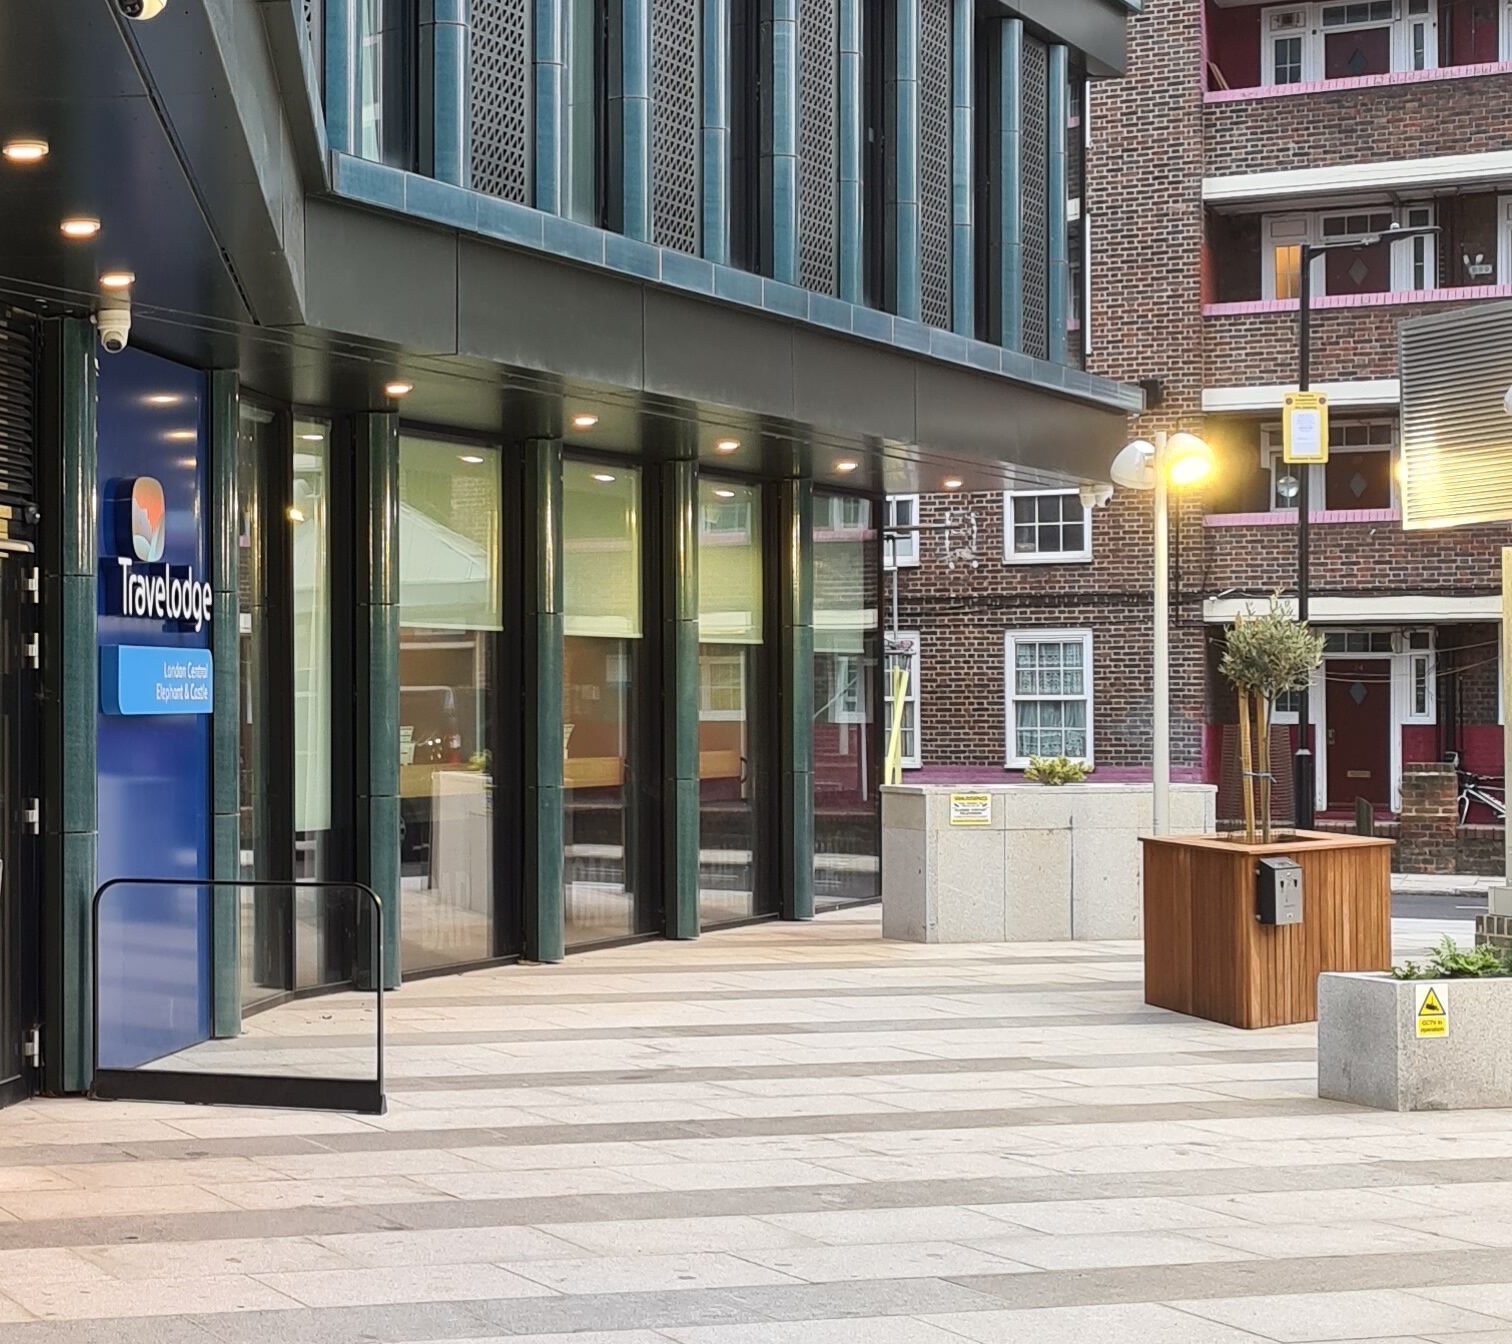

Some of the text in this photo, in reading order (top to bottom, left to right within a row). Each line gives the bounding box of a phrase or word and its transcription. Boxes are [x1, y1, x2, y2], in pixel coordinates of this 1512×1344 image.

[118, 557, 212, 632] Travelodge
[164, 661, 208, 679] London Central
[156, 683, 208, 704] Elephant & Castle
